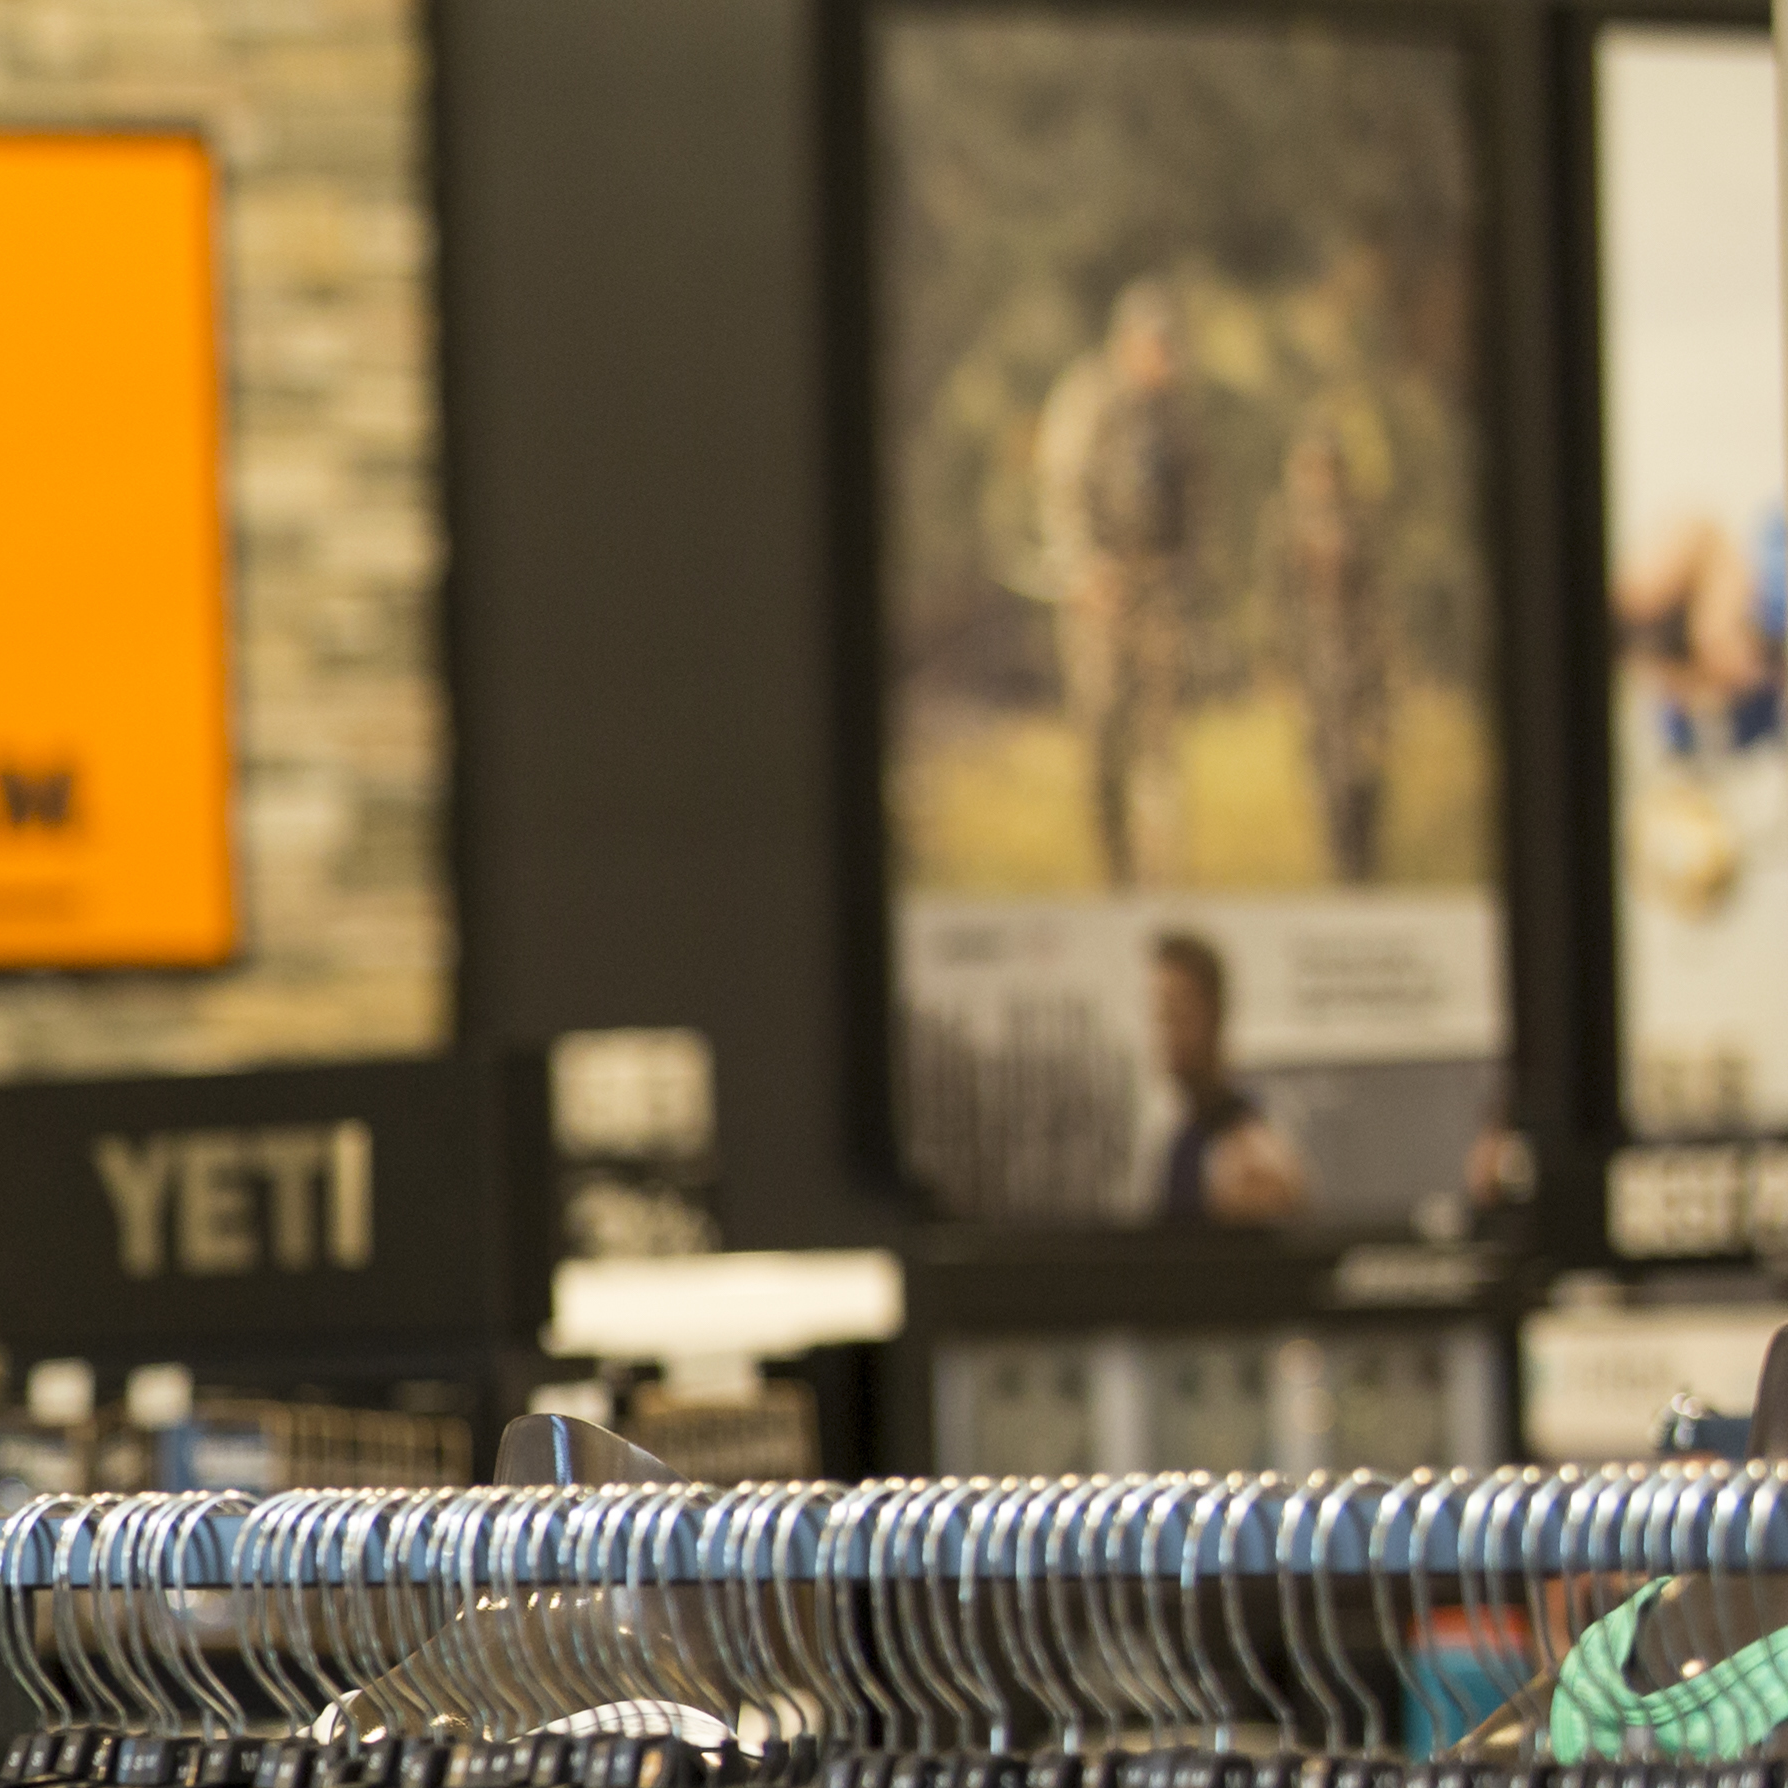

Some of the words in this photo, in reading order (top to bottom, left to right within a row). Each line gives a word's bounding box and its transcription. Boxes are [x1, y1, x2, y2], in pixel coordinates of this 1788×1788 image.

[95, 1118, 373, 1278] YETI
[8, 1751, 22, 1767] S
[31, 1751, 45, 1767] S
